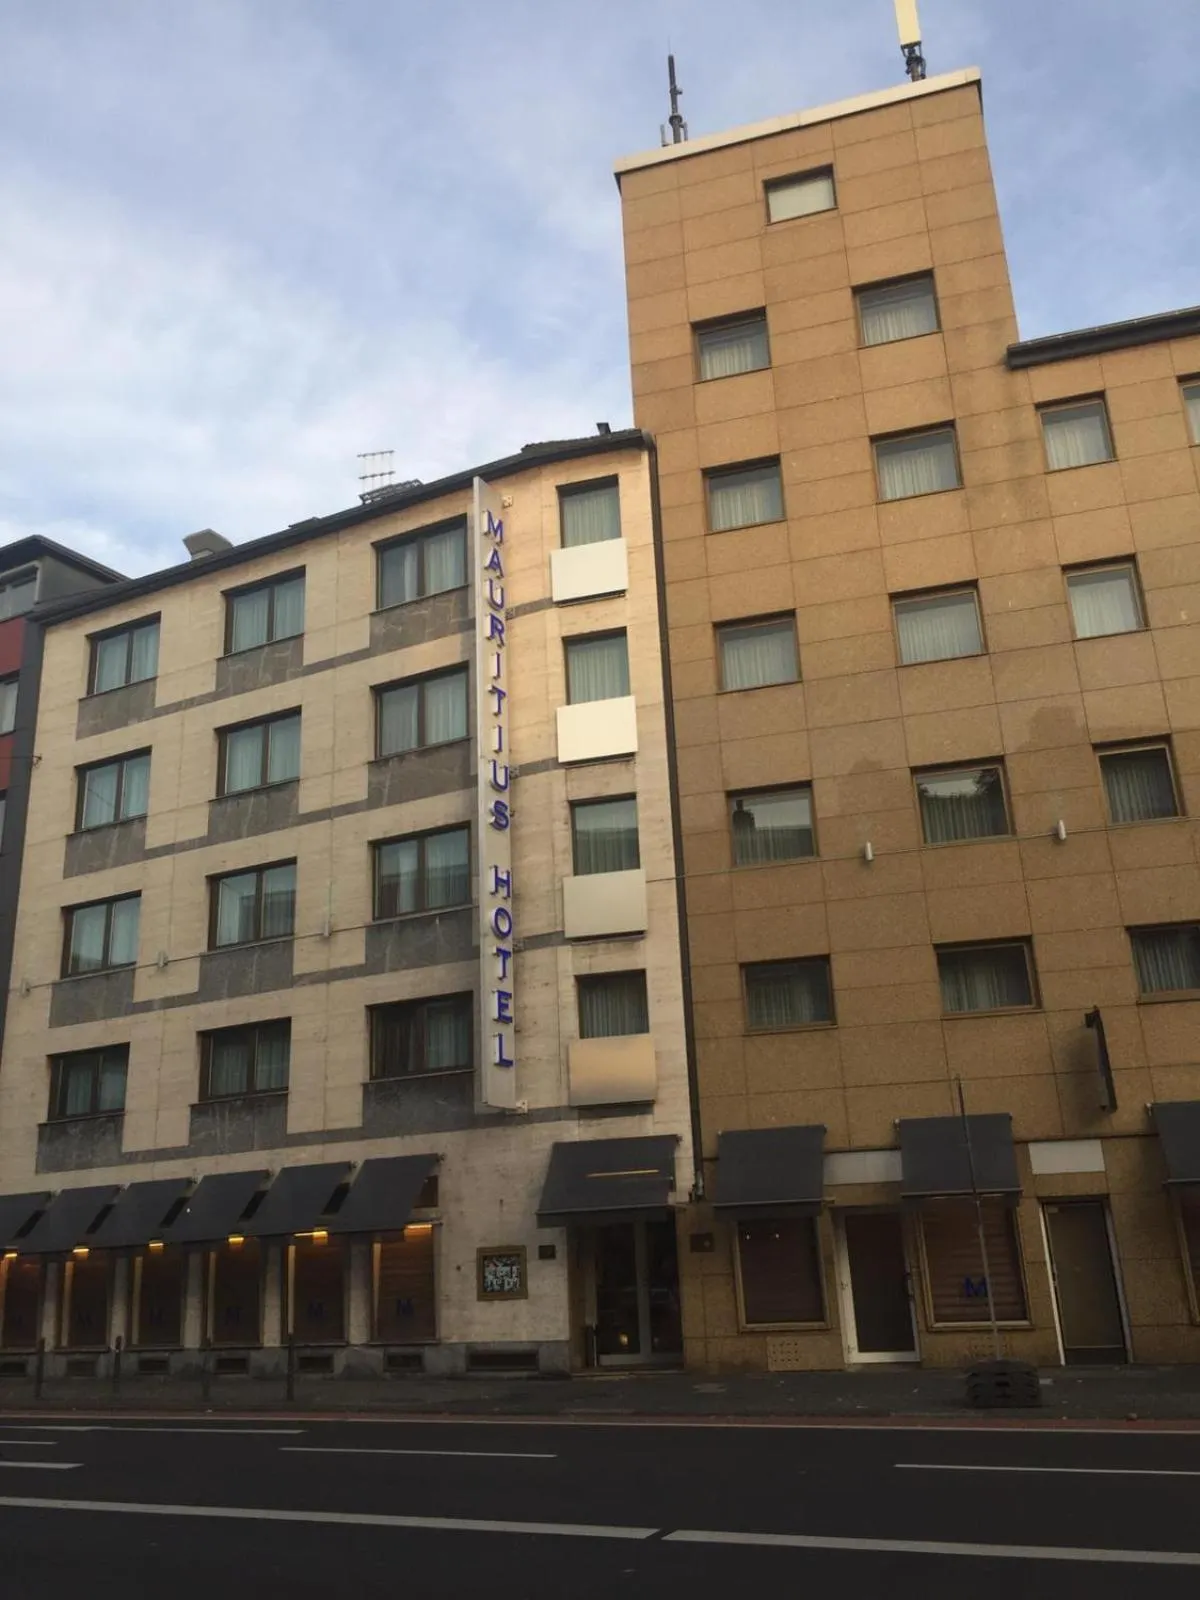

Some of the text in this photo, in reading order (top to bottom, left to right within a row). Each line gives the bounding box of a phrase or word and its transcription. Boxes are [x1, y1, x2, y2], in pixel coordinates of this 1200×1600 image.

[484, 509, 514, 1067] MAURITIUS HOTEL
[963, 1276, 989, 1298] M
